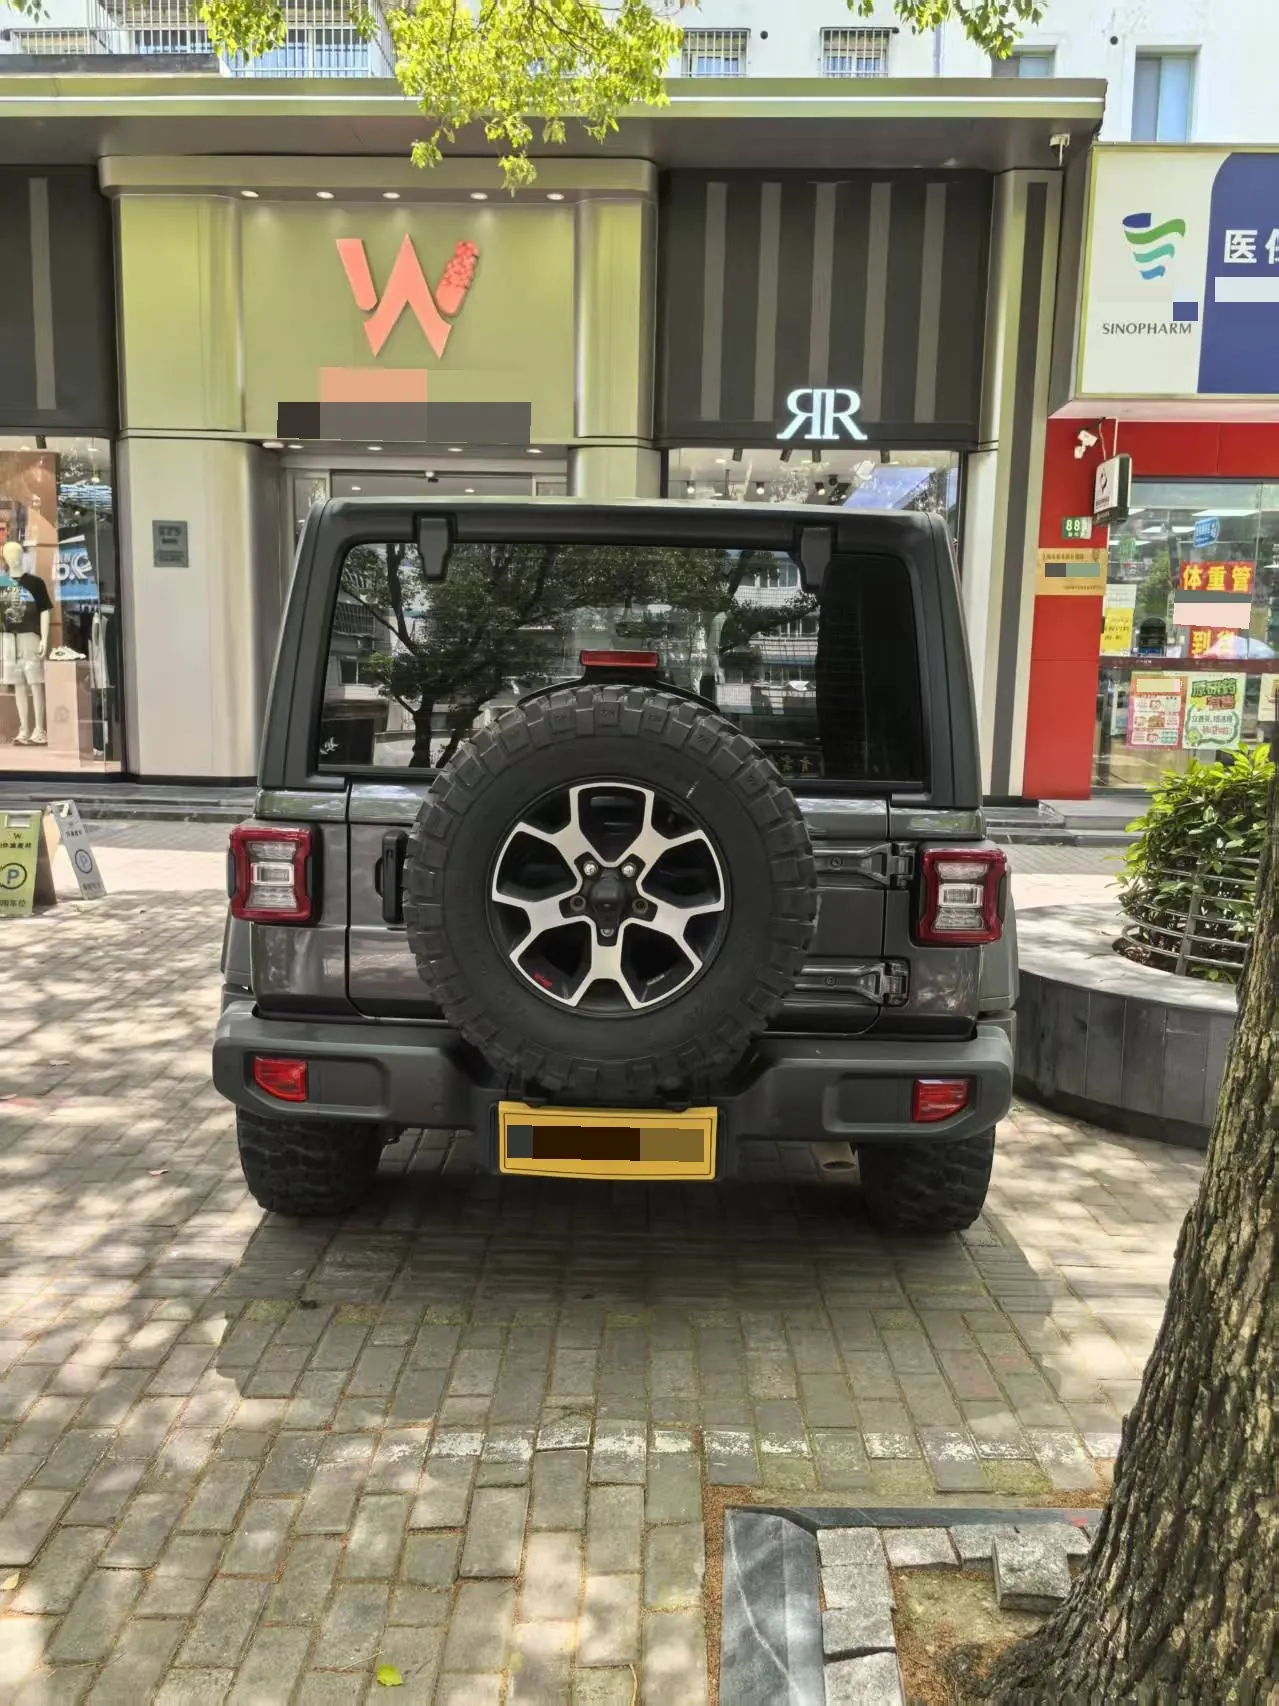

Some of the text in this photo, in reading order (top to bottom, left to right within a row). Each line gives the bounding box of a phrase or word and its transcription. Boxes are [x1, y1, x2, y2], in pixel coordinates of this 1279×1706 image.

[1102, 322, 1192, 334] SINOPHARM
[1183, 564, 1251, 592] 体重管
